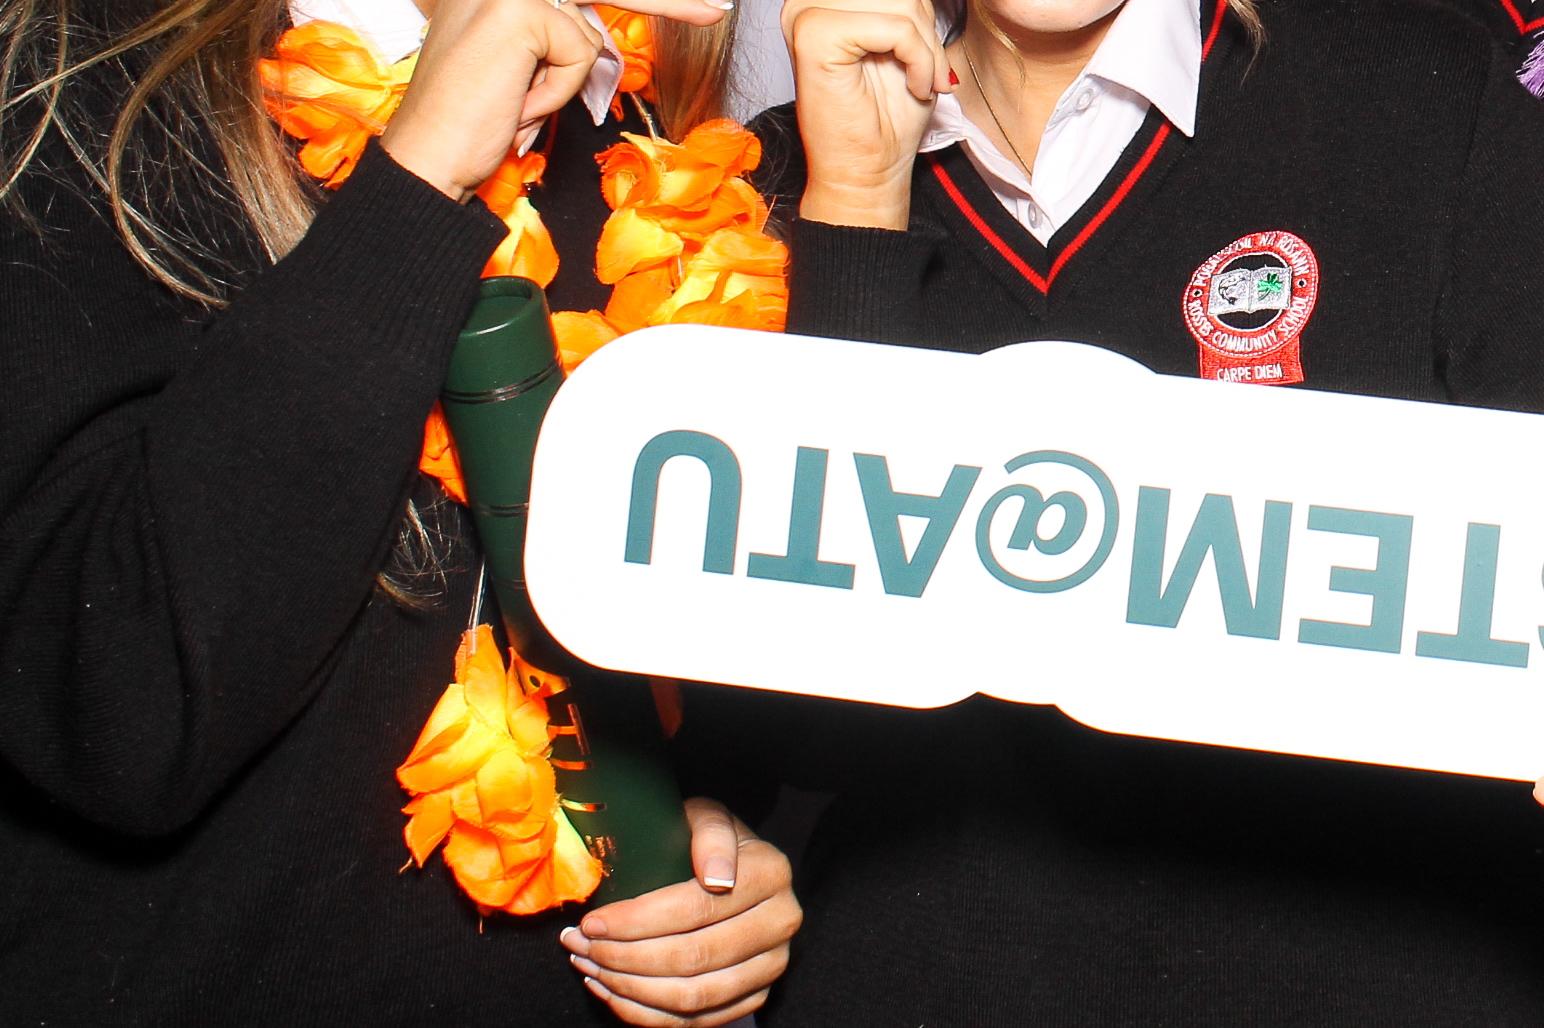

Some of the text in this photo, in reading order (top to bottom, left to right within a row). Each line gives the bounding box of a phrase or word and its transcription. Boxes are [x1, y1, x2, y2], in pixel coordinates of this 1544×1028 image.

[1212, 329, 1280, 352] COMMUNITY
[1278, 295, 1310, 338] SCHOOL
[1216, 363, 1283, 382] CARPE DIEM
